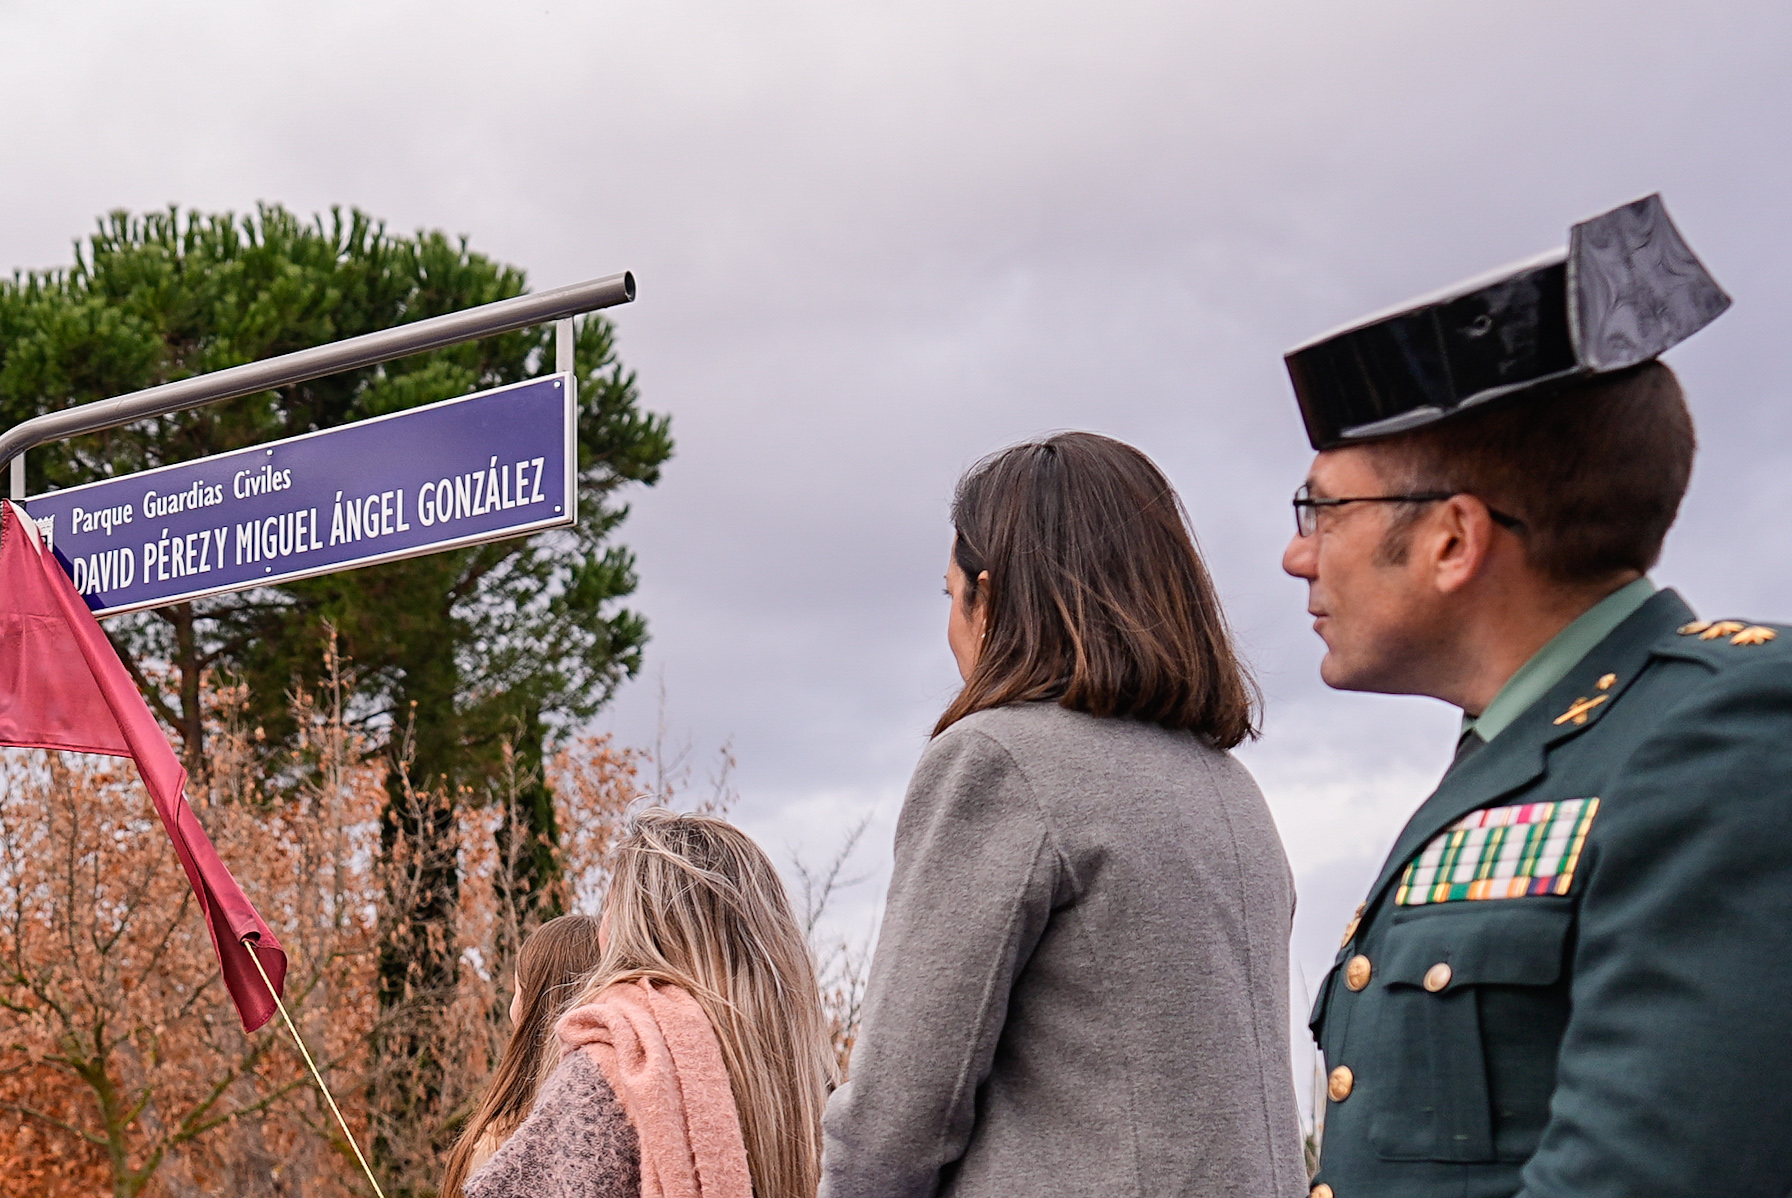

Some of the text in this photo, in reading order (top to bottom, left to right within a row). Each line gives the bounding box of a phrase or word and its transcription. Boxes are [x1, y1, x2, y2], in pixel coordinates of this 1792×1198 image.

[71, 465, 292, 536] Parque Guardias Civiles
[73, 547, 135, 596] DAVID
[235, 507, 324, 565] MIGUEL
[329, 490, 410, 547] ÁNGEL
[417, 455, 545, 527] GONZÁLEZ
